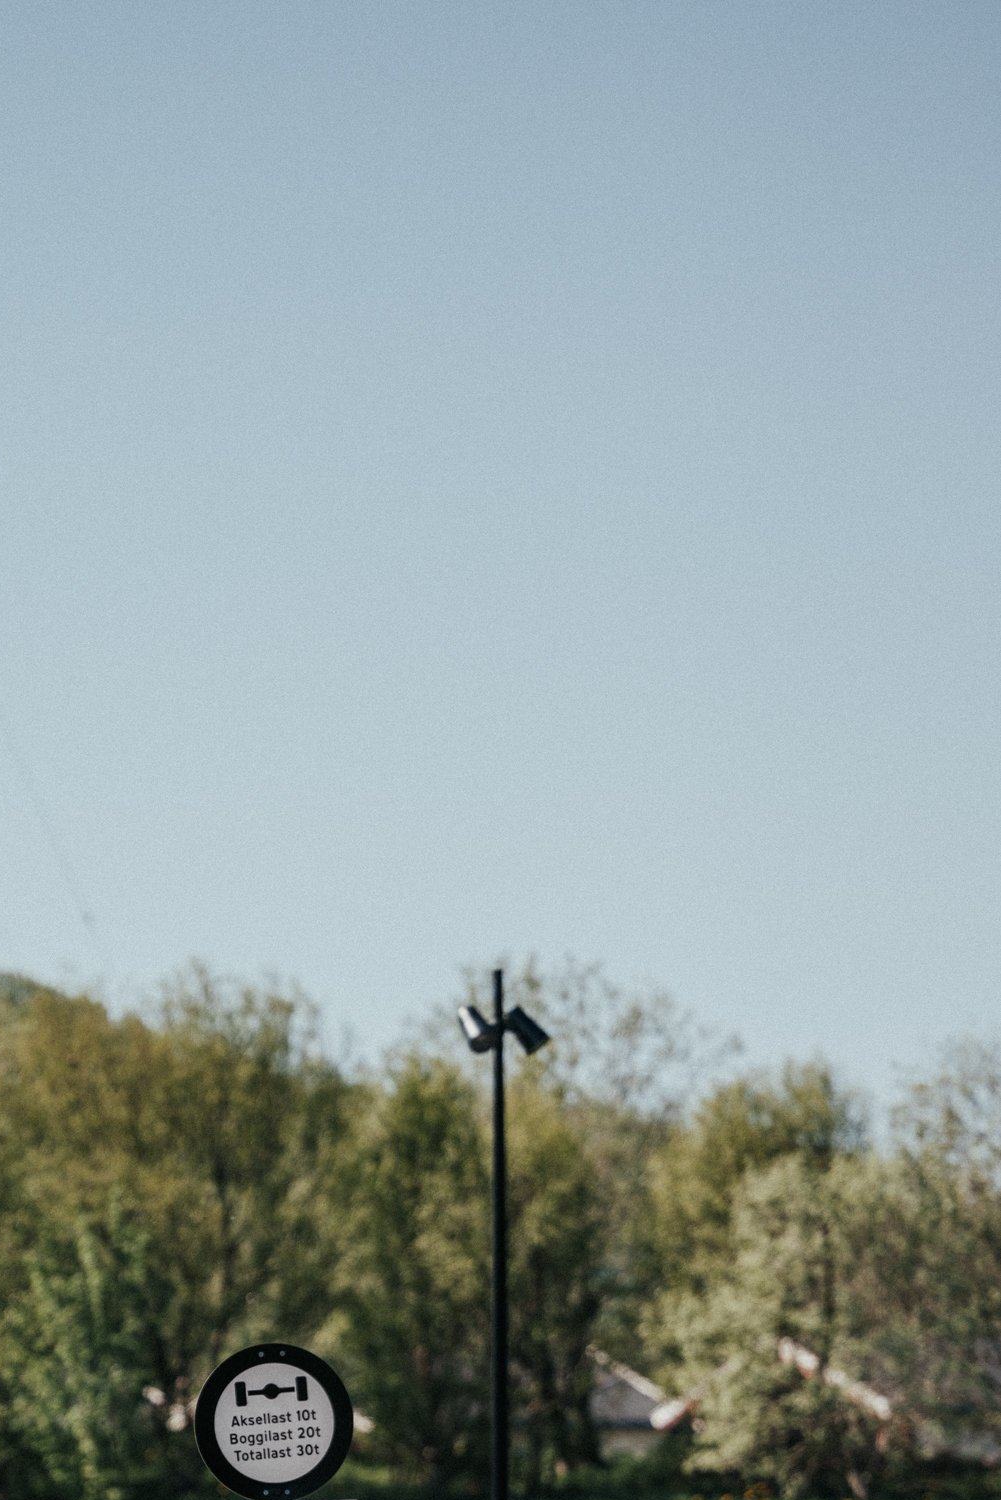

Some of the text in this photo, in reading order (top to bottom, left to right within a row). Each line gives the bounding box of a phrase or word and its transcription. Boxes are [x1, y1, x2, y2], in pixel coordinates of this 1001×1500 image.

[231, 1409, 317, 1427] Aksellast 10t
[229, 1426, 321, 1446] Boggilast 20t
[234, 1444, 320, 1462] Totallast 30t
